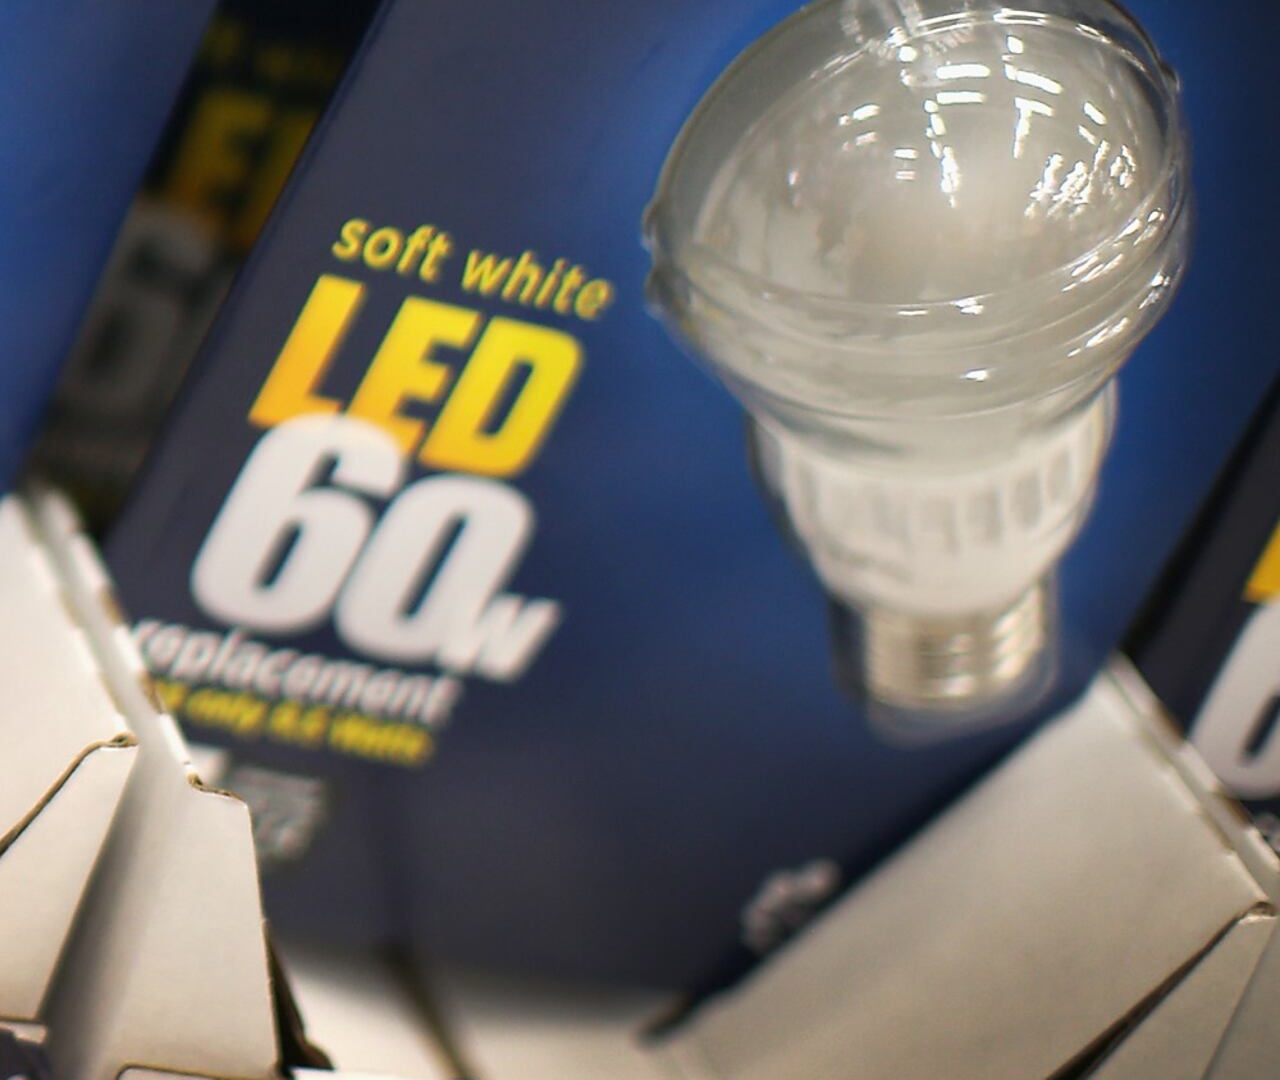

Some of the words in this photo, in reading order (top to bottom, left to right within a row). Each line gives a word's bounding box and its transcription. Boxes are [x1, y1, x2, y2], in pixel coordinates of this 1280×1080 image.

[331, 217, 450, 282] soft
[461, 246, 613, 320] white
[250, 274, 582, 476] LED
